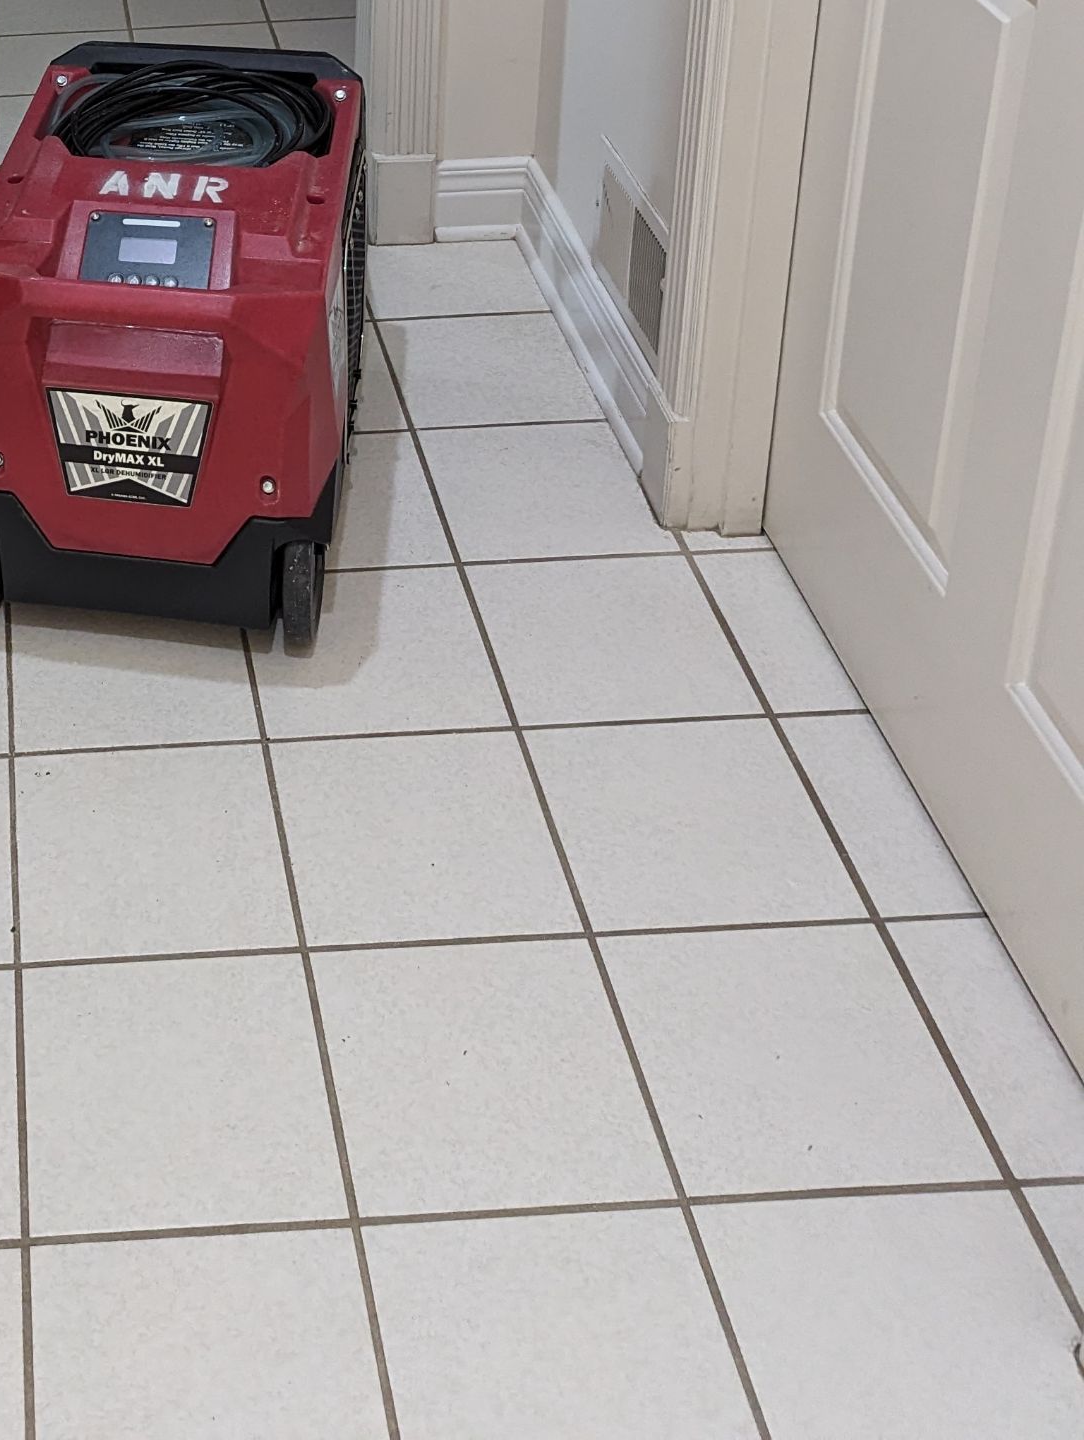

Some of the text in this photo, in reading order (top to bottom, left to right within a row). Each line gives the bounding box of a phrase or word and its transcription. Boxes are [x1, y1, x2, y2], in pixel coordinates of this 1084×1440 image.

[98, 170, 229, 203] ANR
[85, 430, 172, 451] PHOENIX
[93, 450, 165, 467] DryMAX XL
[116, 469, 167, 480] DEHUMIDIFIER
